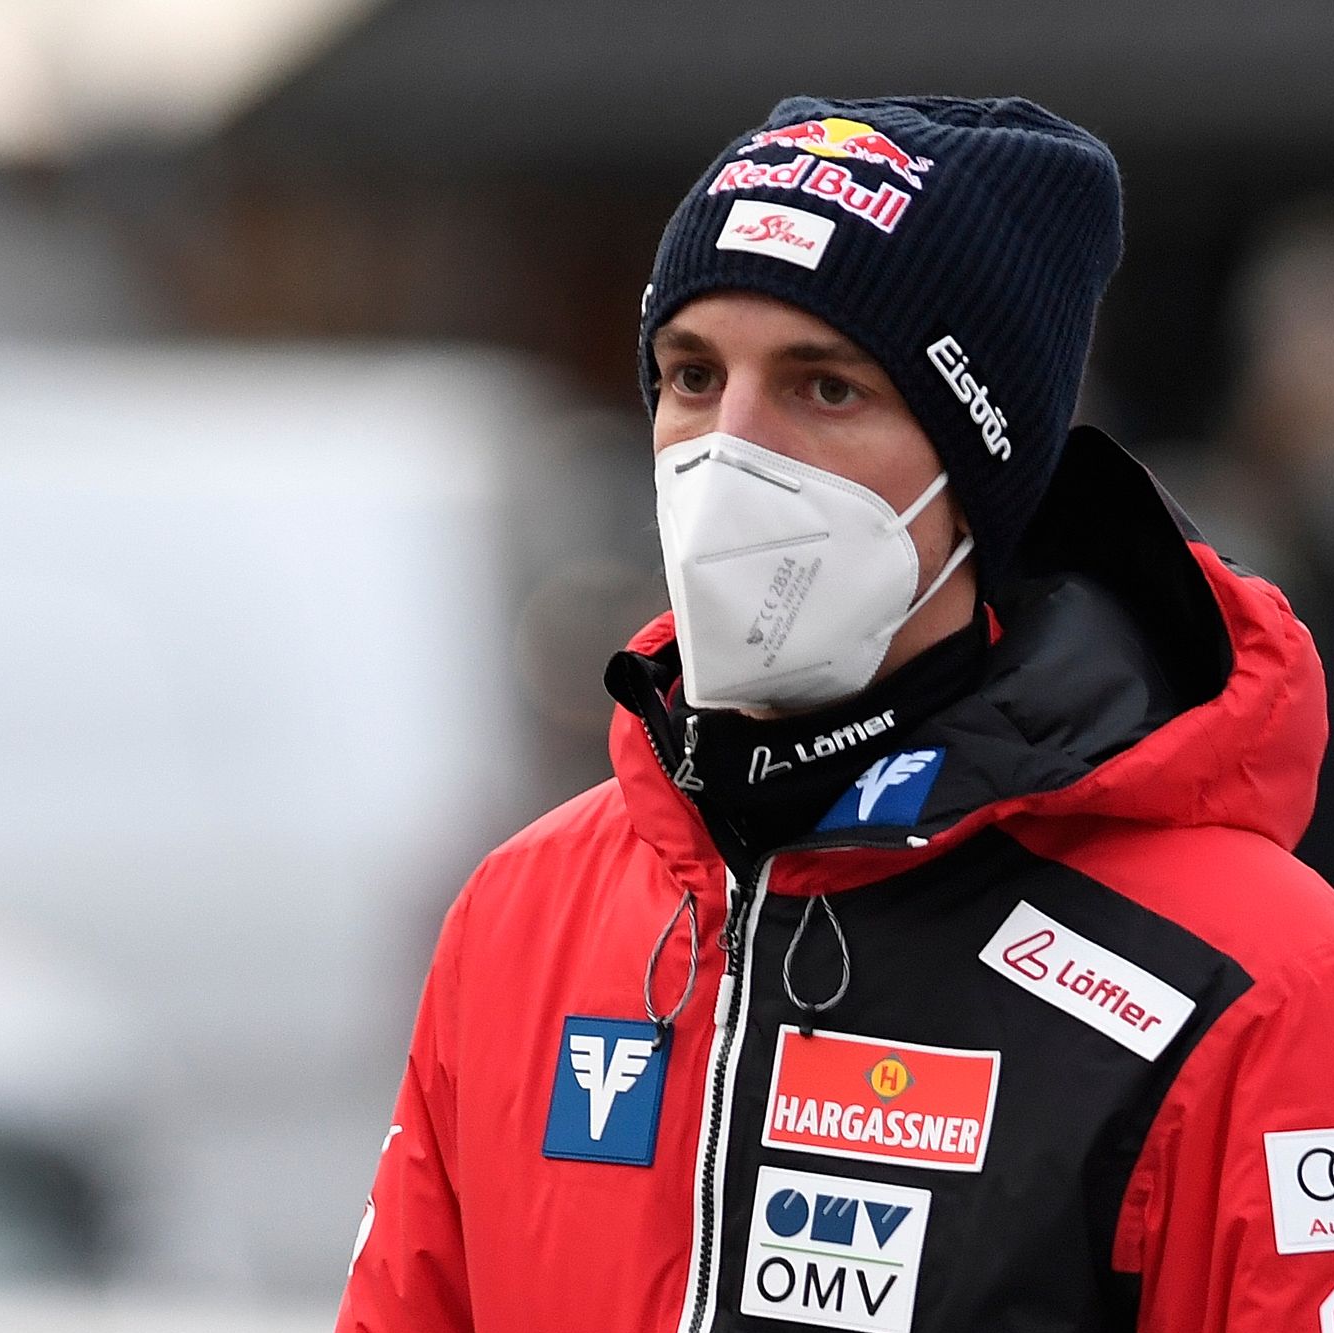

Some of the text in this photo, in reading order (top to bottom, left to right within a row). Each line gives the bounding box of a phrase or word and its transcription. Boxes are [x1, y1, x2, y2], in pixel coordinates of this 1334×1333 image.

[708, 155, 911, 234] Red Bull
[927, 335, 1011, 461] Eisbär
[769, 557, 796, 597] 2834
[795, 709, 895, 763] Löffler
[1056, 960, 1162, 1032] Löffler
[879, 1065, 898, 1091] H
[774, 1095, 980, 1154] HARGASSNER
[757, 1256, 898, 1317] OMV
